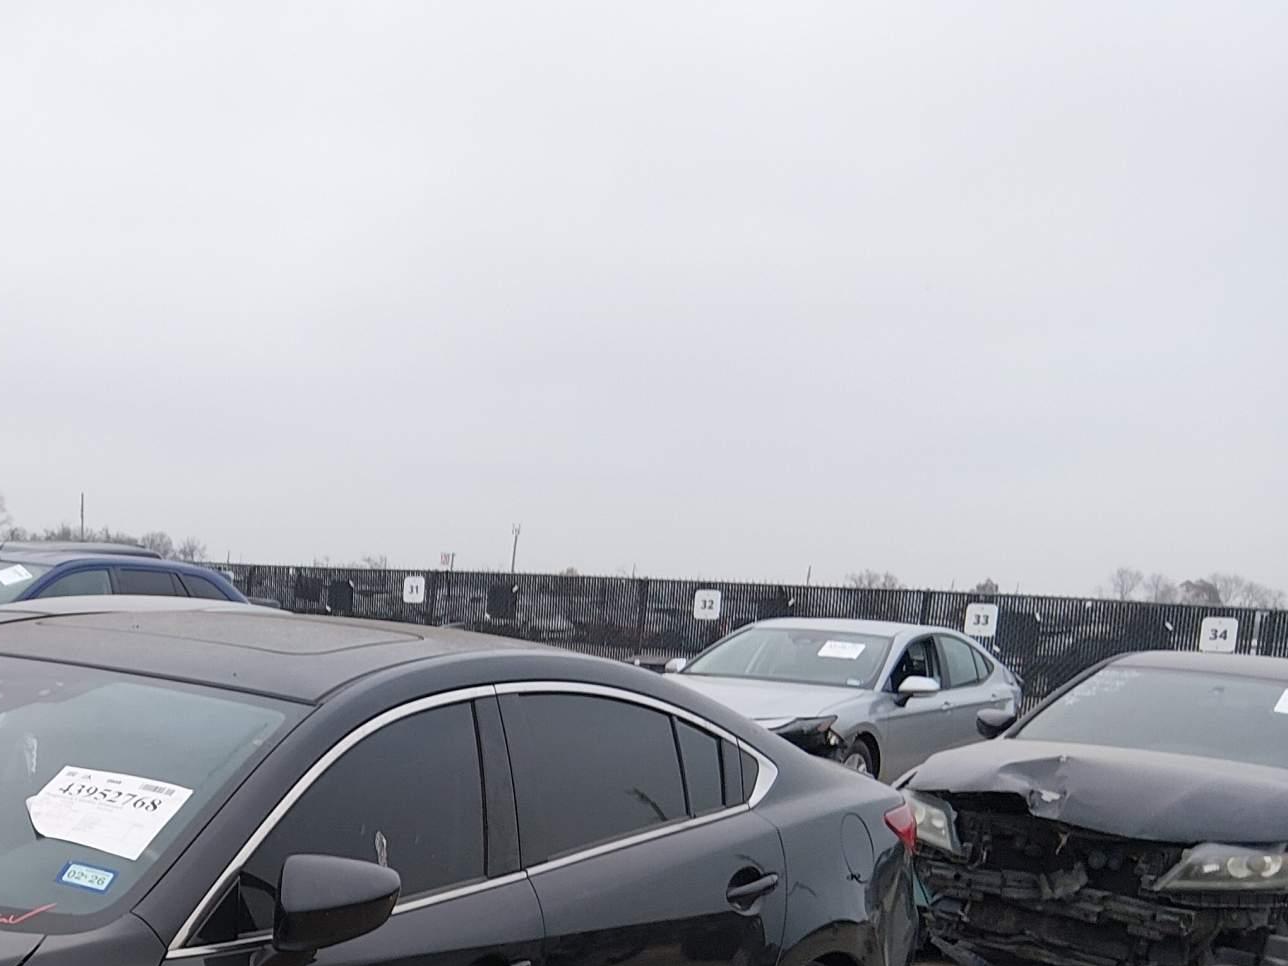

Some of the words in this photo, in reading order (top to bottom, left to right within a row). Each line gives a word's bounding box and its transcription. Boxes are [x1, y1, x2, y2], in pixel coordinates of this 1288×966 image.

[408, 584, 419, 594] 31
[701, 599, 714, 610] 32
[973, 614, 989, 626] 33
[1209, 628, 1228, 641] 34
[58, 782, 162, 812] 43952768
[66, 868, 106, 886] 02-26
